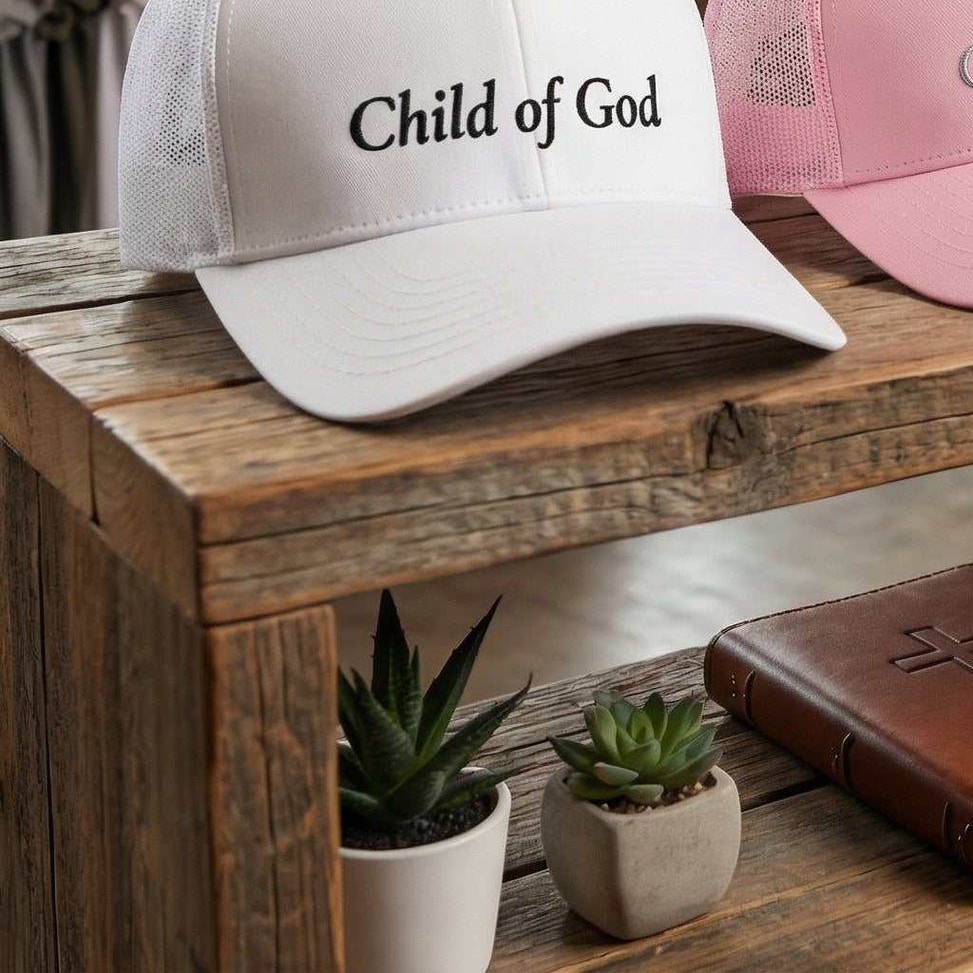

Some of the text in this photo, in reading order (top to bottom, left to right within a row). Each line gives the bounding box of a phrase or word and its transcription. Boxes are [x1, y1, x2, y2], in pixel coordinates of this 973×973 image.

[349, 74, 662, 152] Child of God
